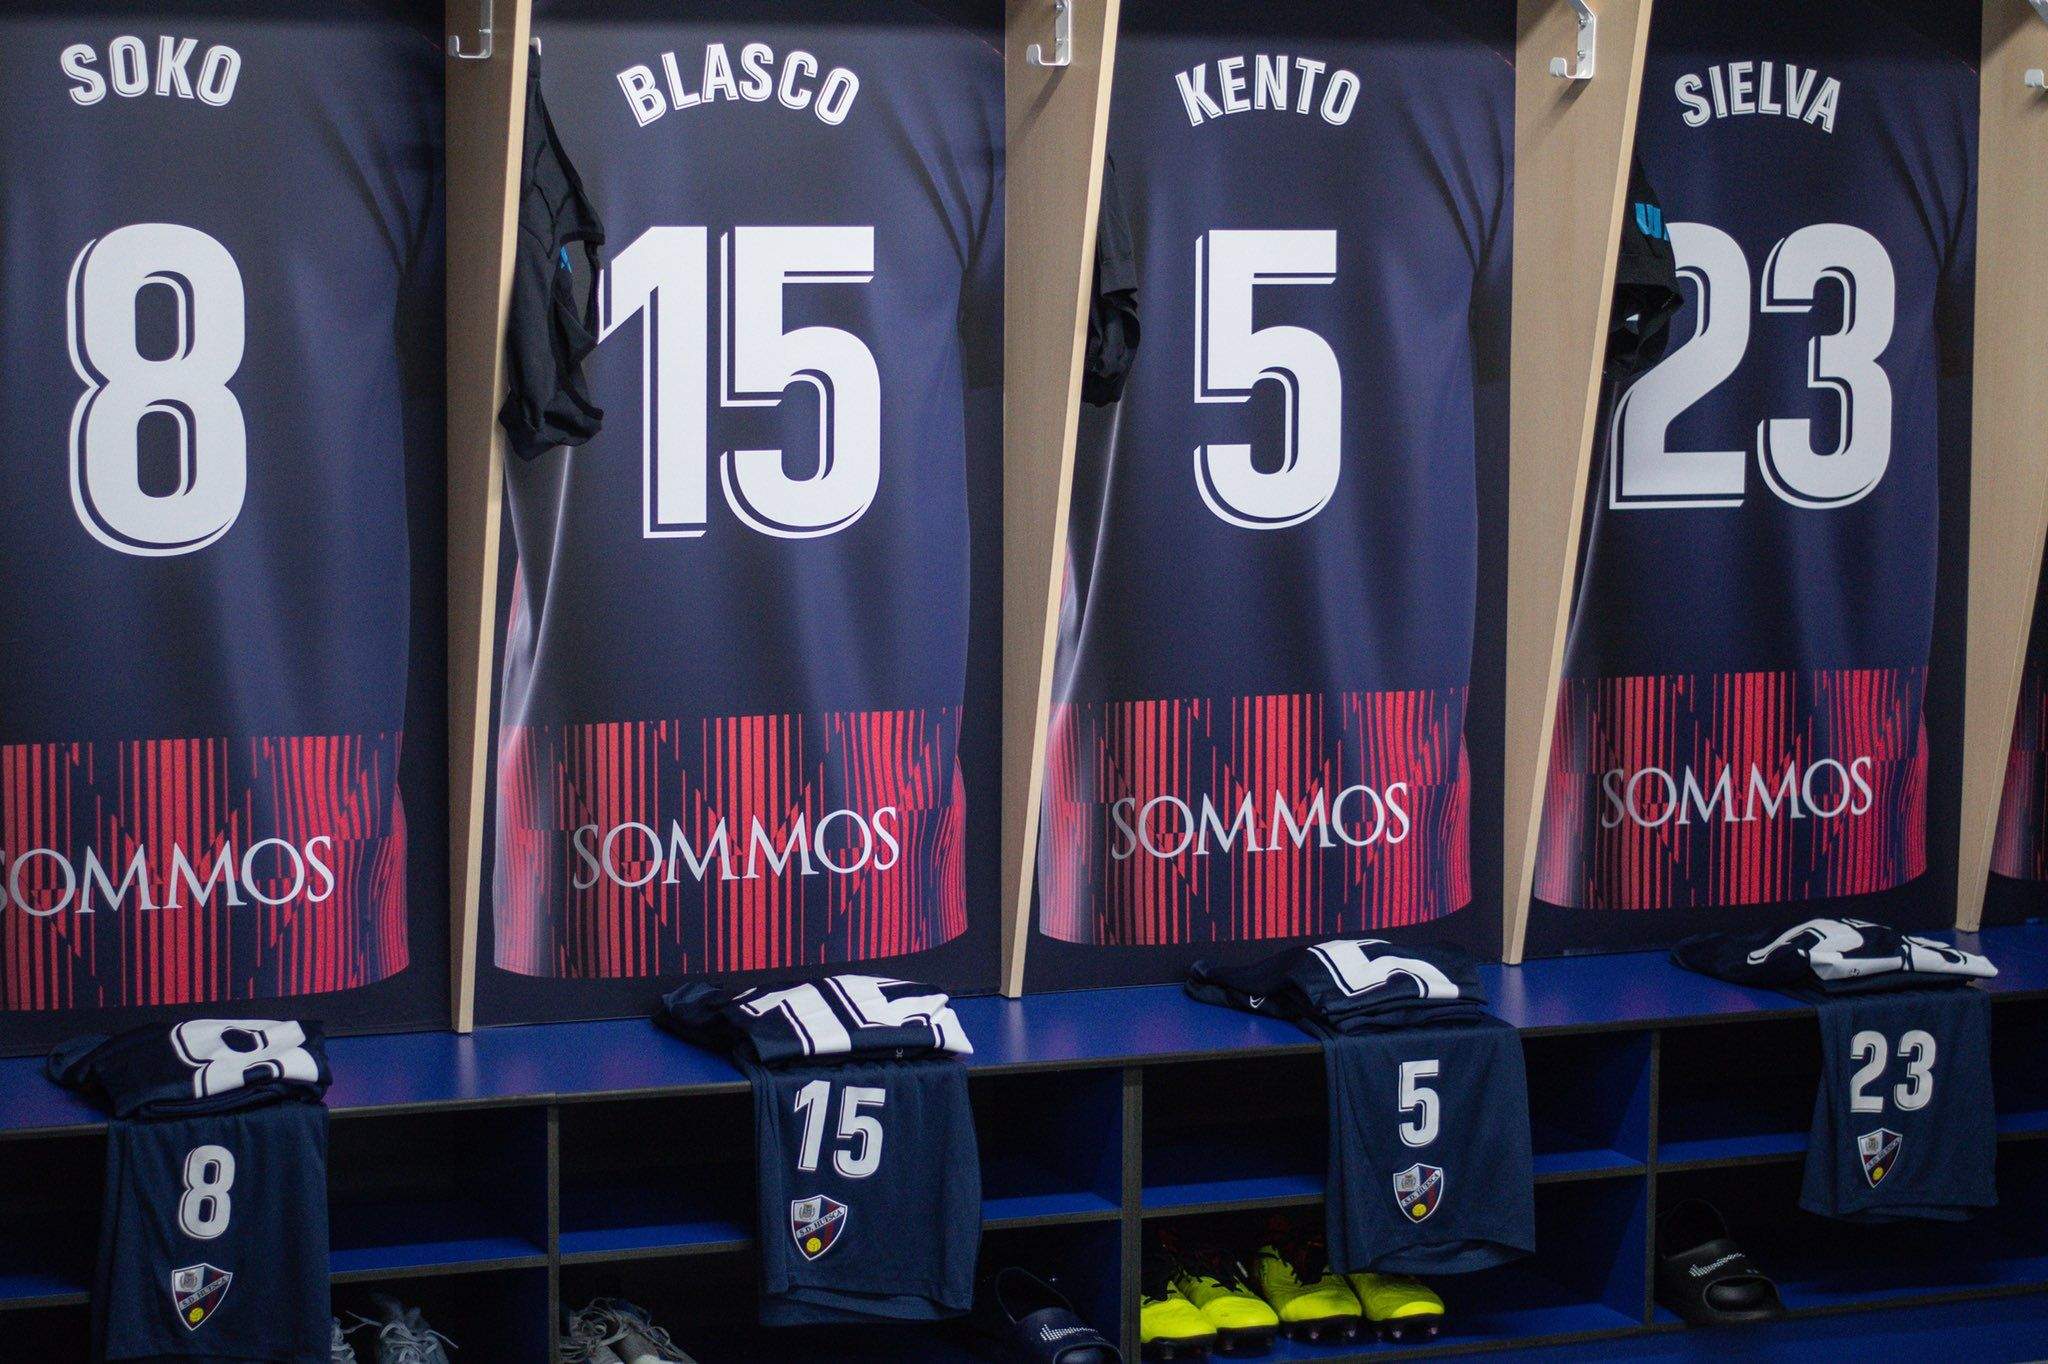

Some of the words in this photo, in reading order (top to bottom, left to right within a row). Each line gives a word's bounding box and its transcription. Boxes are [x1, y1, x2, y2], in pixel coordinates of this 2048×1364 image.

[60, 35, 242, 106] SOKO
[616, 42, 860, 127] BLASCO
[1175, 54, 1361, 126] KENTO
[1674, 60, 1841, 134] SIELVA
[66, 223, 247, 557] 8
[597, 226, 881, 540] 15
[1194, 229, 1342, 531] 5
[1609, 222, 1896, 510] 23
[1110, 782, 1410, 860] SOMMOS
[1601, 756, 1873, 829] SOMMOS
[0, 836, 335, 917] OMMOS
[573, 806, 900, 889] SOMMOS
[1398, 1059, 1440, 1148] 5
[1850, 1030, 1936, 1114] 23
[794, 1080, 886, 1179] 15
[178, 1145, 236, 1240] 8
[813, 1208, 842, 1229] HUESCA
